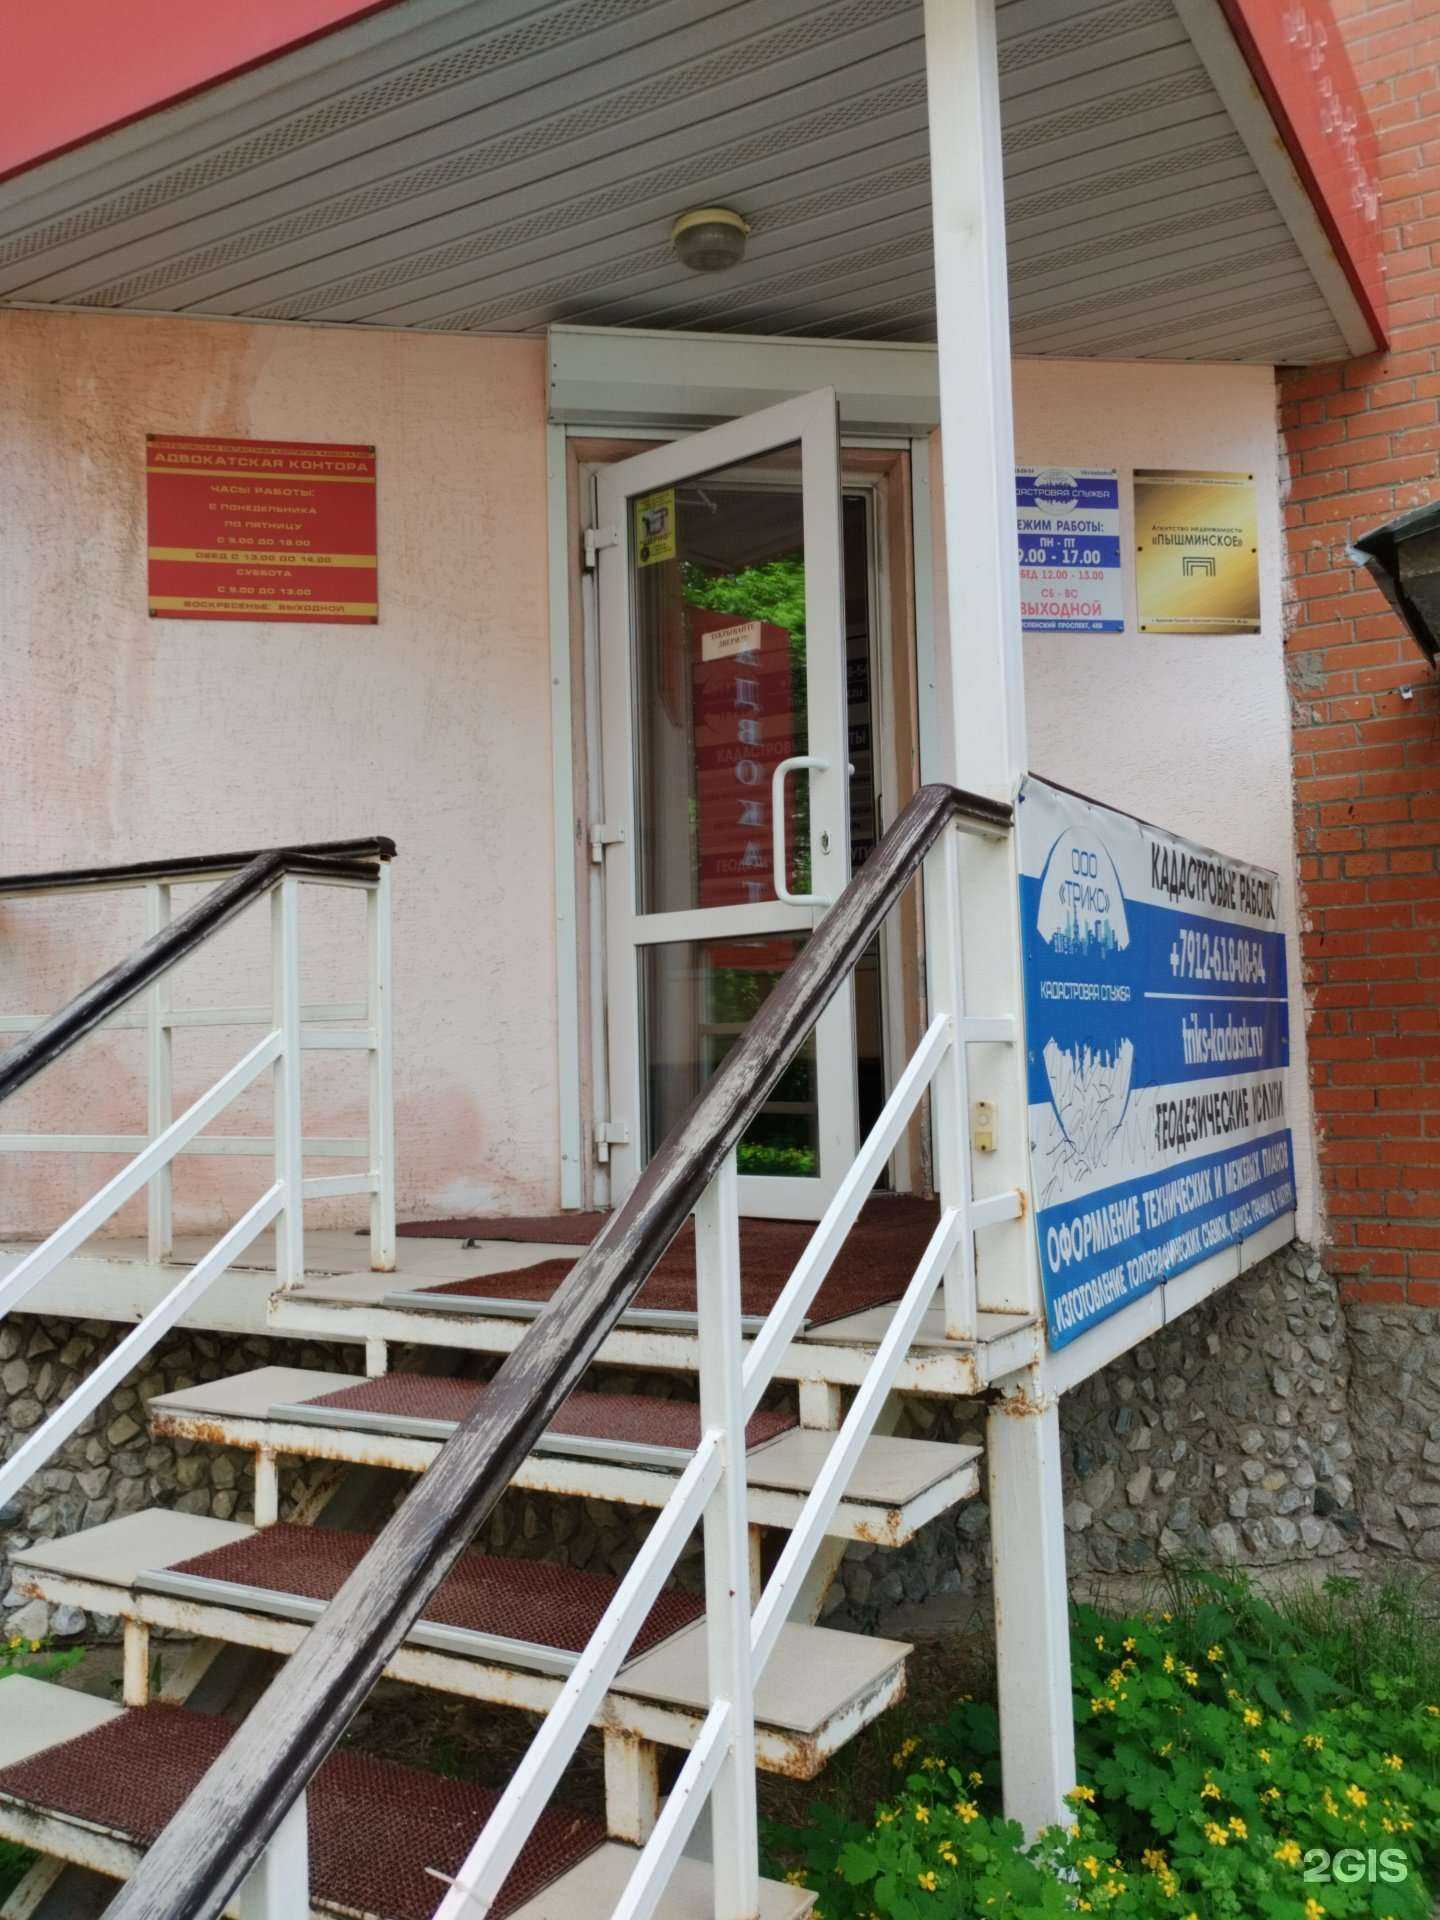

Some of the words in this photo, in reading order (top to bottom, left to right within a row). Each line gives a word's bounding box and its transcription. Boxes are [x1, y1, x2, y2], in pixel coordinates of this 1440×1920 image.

[154, 451, 284, 469] АДВОКАТСКАЯ
[289, 459, 369, 473] КОНТОРА
[210, 485, 250, 495] ЧАСЫ
[220, 503, 317, 514] ПОНЕДЕЛЬНИКА
[224, 520, 242, 528] ПО
[245, 521, 303, 531] ПЯТНИЦУ
[1017, 520, 1051, 530] ЕЖИМ
[1056, 520, 1104, 532] РАБОТЫ:
[217, 536, 225, 544] С
[258, 538, 275, 546] ДО
[1040, 537, 1054, 548] ПН
[1064, 538, 1076, 549] ПТ
[1152, 534, 1243, 547] «ПЫШМИНСКОЕ»
[231, 553, 240, 561] С
[279, 555, 296, 563] ДО
[1062, 549, 1100, 564] 17.00
[236, 568, 292, 577] СУББОТА
[1020, 569, 1038, 580] БЕД
[217, 585, 225, 593] С
[259, 587, 275, 595] ДО
[278, 604, 344, 613] ВЫХОДНОЙ
[1071, 848, 1098, 879] ООО
[1152, 842, 1236, 910] КАДАСТРОВЫЕ
[1058, 880, 1111, 913] «ТРИКС»
[1040, 981, 1100, 1000] КАДАСТРОВАЯ
[1155, 1088, 1249, 1154] ГЕОДЕЗИЧЕСКИЕ
[1047, 1195, 1140, 1273] ОФОРМЛЕНИЕ
[1142, 1169, 1213, 1230] ТЕХНИЧЕСКИХ
[1214, 1165, 1223, 1199] И
[1053, 1265, 1127, 1332] ИЗГОТОВЛЕНИЕ
